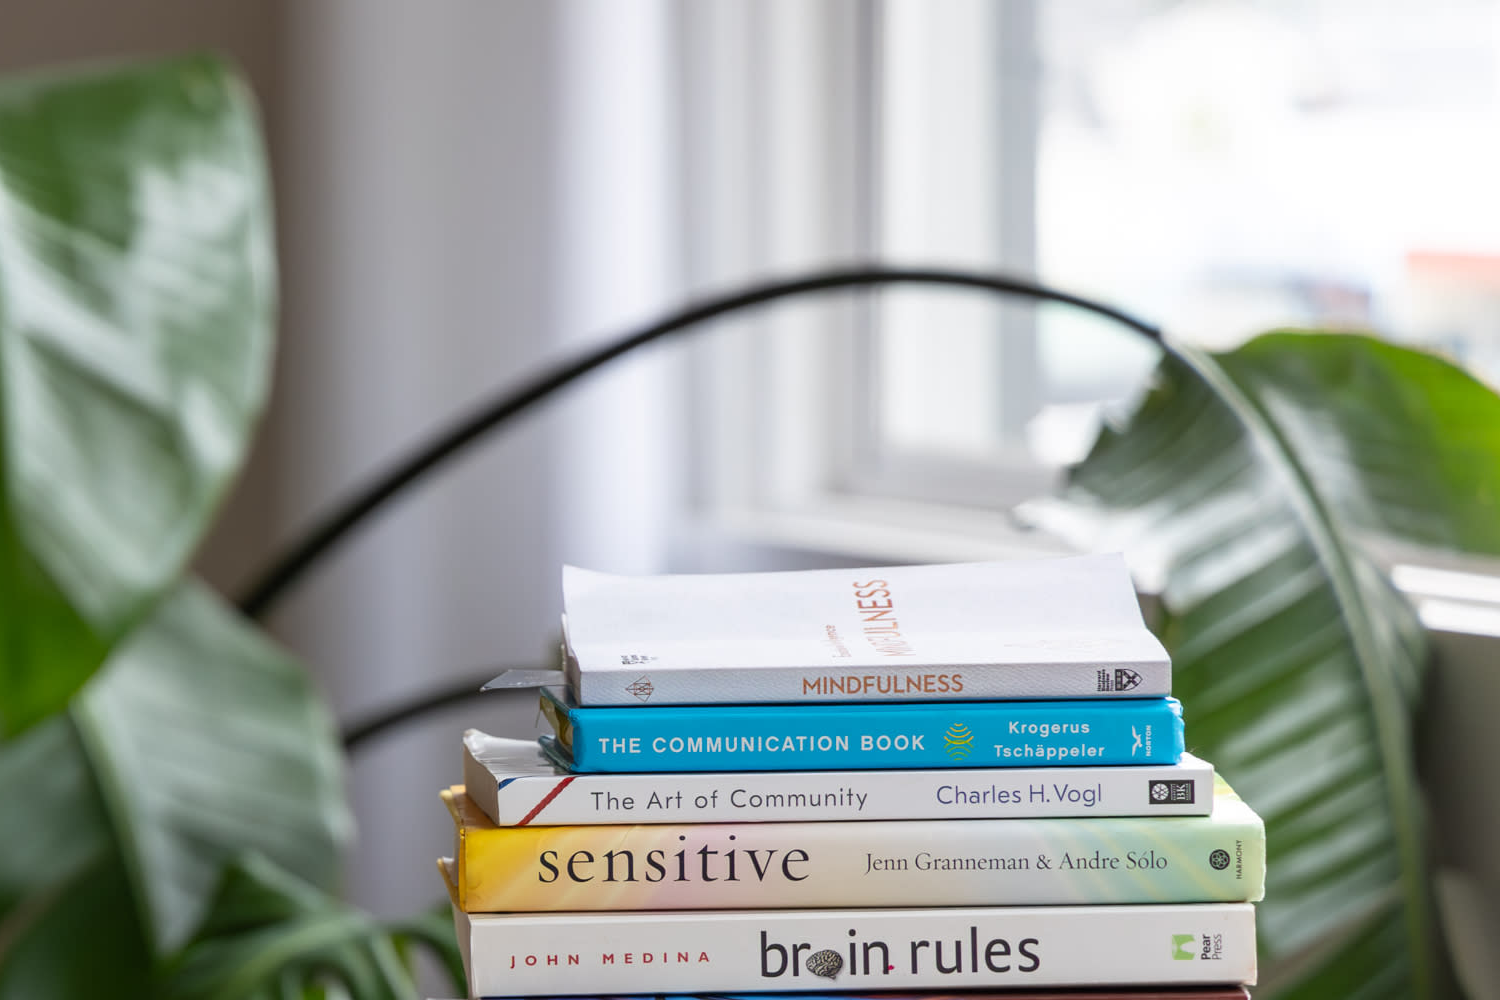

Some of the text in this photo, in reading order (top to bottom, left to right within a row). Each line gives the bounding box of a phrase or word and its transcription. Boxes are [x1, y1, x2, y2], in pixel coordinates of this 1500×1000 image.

[852, 579, 916, 657] MFULNESS
[802, 674, 964, 696] MINDFULNESS
[1009, 722, 1090, 737] Krogerus
[598, 733, 925, 754] THE COMMUNICATION BOOK
[994, 744, 1104, 760] Tschäppeler
[591, 786, 868, 811] The Art of Community
[937, 783, 1101, 808] Charles H. Vogl
[1177, 784, 1186, 800] BK
[538, 835, 809, 883] sensitive
[864, 851, 1167, 875] Jenn Granneman & Andre Sólo
[760, 926, 1040, 978] brin rules
[1201, 934, 1211, 960] Pear
[1214, 934, 1222, 960] Press
[510, 952, 710, 968] JOHN MEDINA
